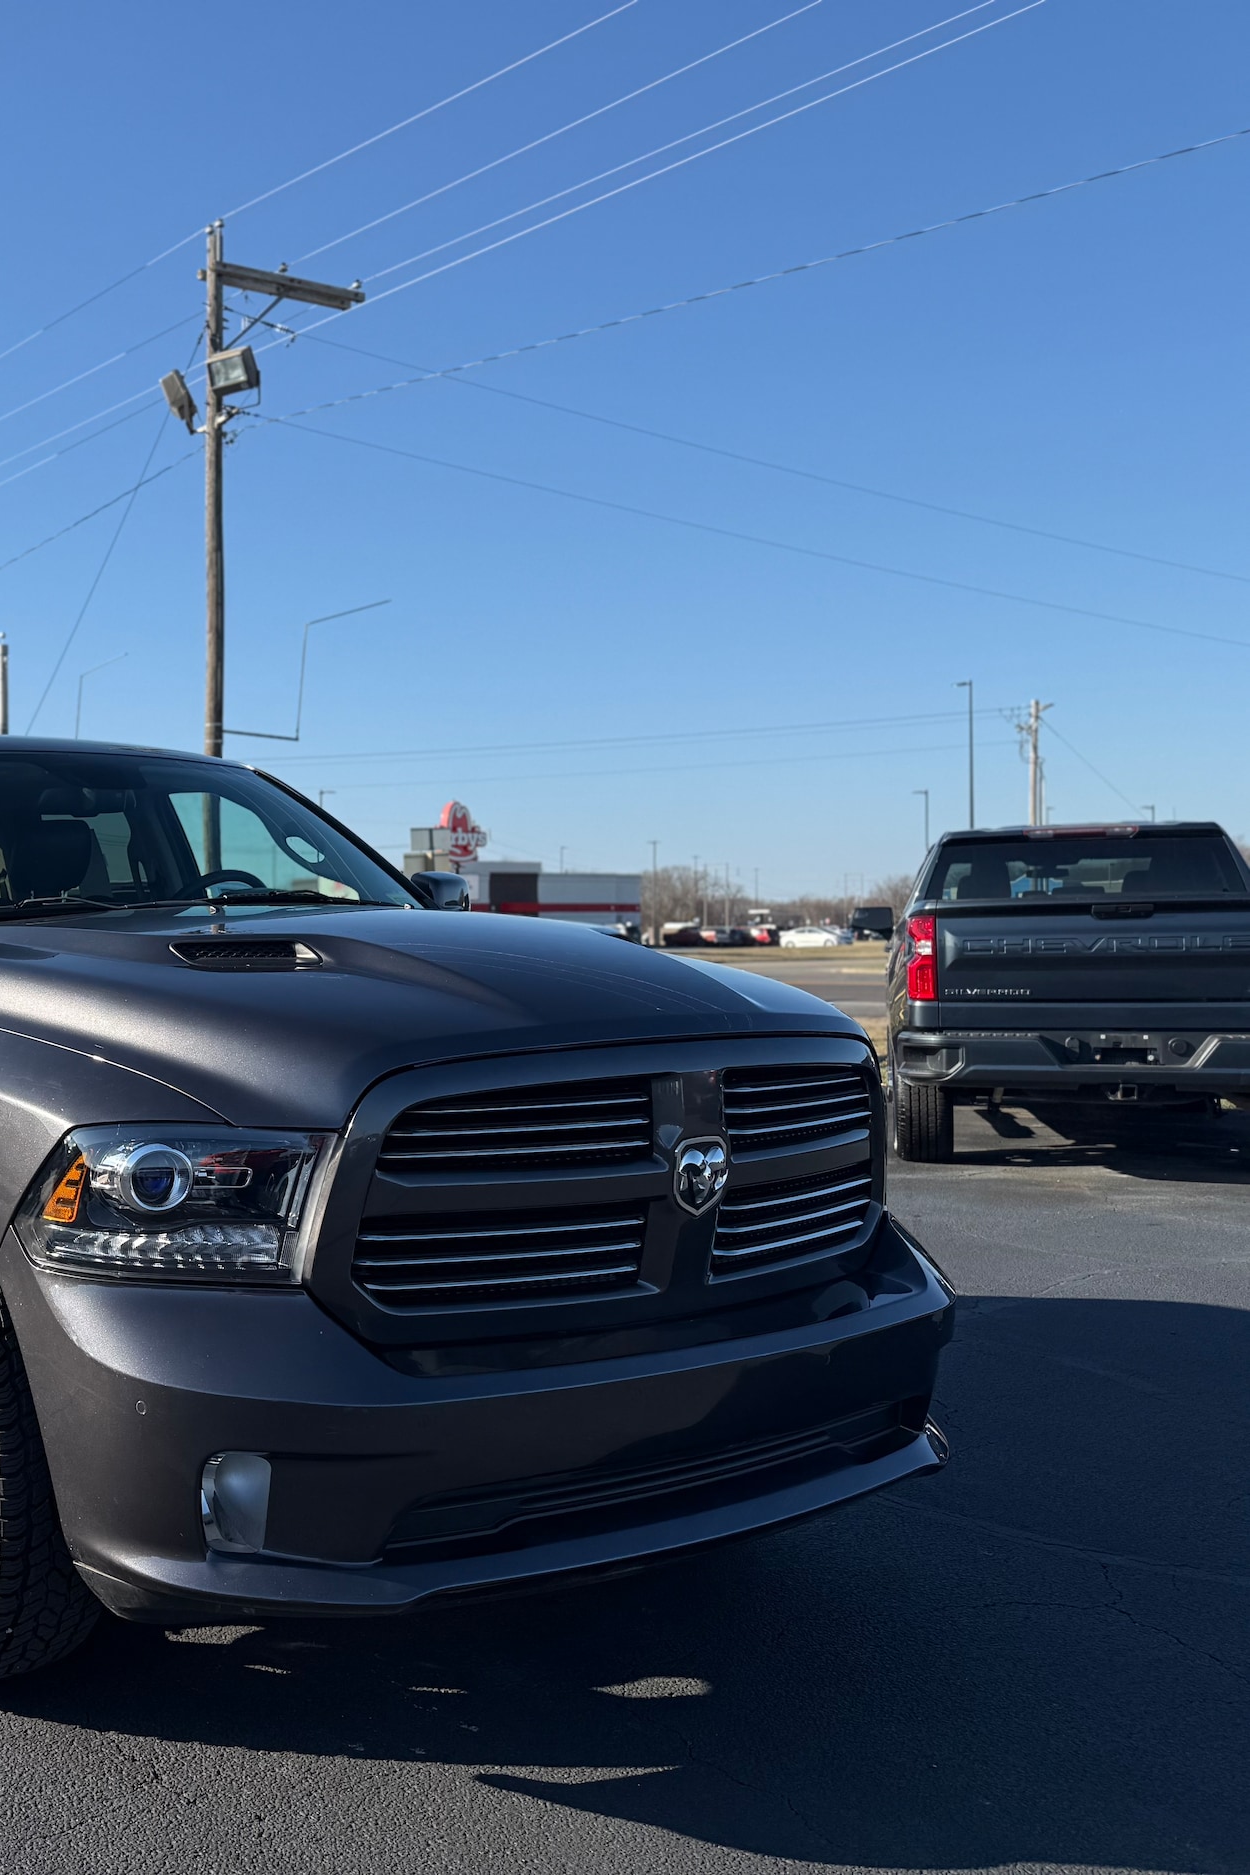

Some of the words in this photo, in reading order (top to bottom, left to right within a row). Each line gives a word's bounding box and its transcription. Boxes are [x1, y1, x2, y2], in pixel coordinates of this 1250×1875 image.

[450, 826, 488, 851] rbys
[963, 934, 1250, 954] CHEVROLE
[944, 988, 1030, 996] SILVERADO
